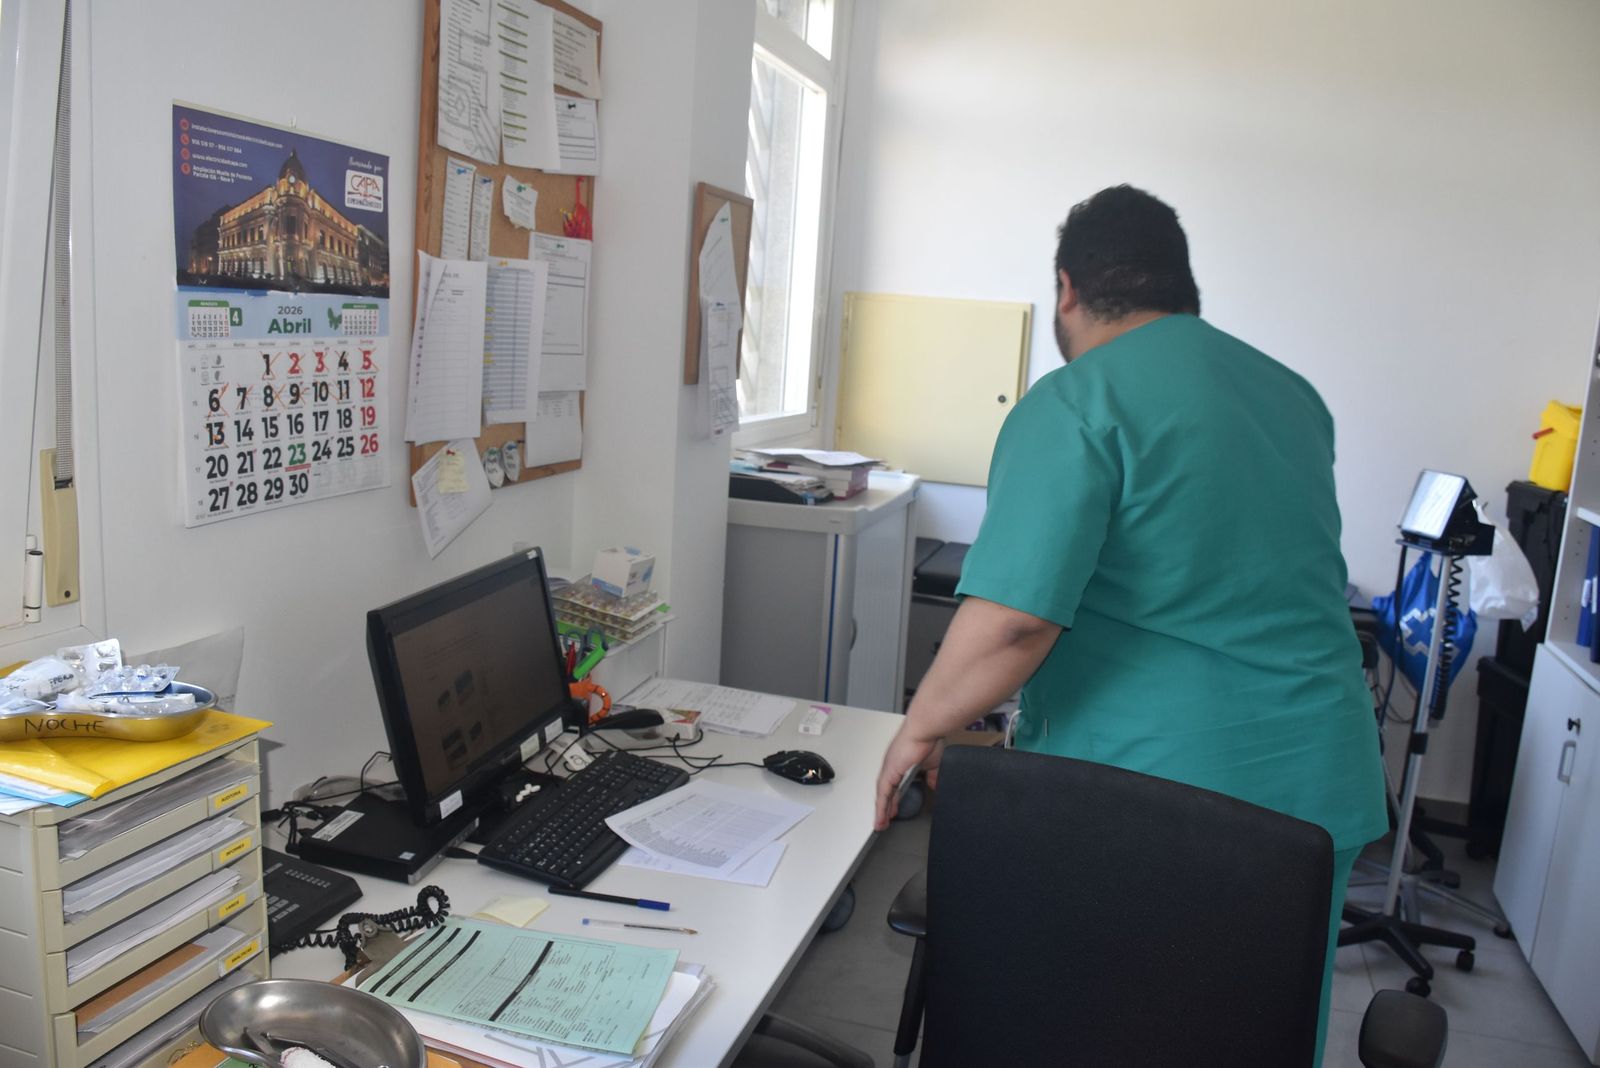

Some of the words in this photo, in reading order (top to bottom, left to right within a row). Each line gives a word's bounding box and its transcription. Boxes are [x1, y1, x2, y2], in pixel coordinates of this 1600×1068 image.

[232, 311, 239, 324] 4
[277, 306, 303, 315] 2026
[268, 319, 311, 334] Abril
[262, 354, 271, 375] 1
[288, 353, 300, 374] 2
[315, 352, 325, 373] 3
[338, 352, 349, 371] 4
[363, 351, 372, 370] 5
[208, 389, 220, 412] 6
[237, 388, 247, 409] 7
[263, 385, 274, 407] 8
[289, 383, 300, 404] 9
[312, 381, 329, 401] 10
[338, 380, 350, 400] 11
[360, 378, 375, 398] 12
[206, 422, 225, 446] 13
[234, 419, 254, 442] 14
[262, 416, 279, 439] 15
[287, 414, 304, 435] 16
[313, 411, 329, 432] 17
[337, 408, 353, 428] 18
[360, 406, 376, 426] 19
[206, 454, 228, 479] 20
[237, 451, 254, 475] 21
[263, 447, 282, 469] 22
[288, 443, 306, 465] 23
[312, 441, 332, 462] 24
[337, 437, 354, 457] 25
[360, 434, 379, 455] 26
[209, 487, 229, 512] 27
[236, 482, 258, 506] 28
[264, 477, 284, 501] 29
[289, 473, 309, 496] 30
[25, 718, 106, 735] NOCHE
